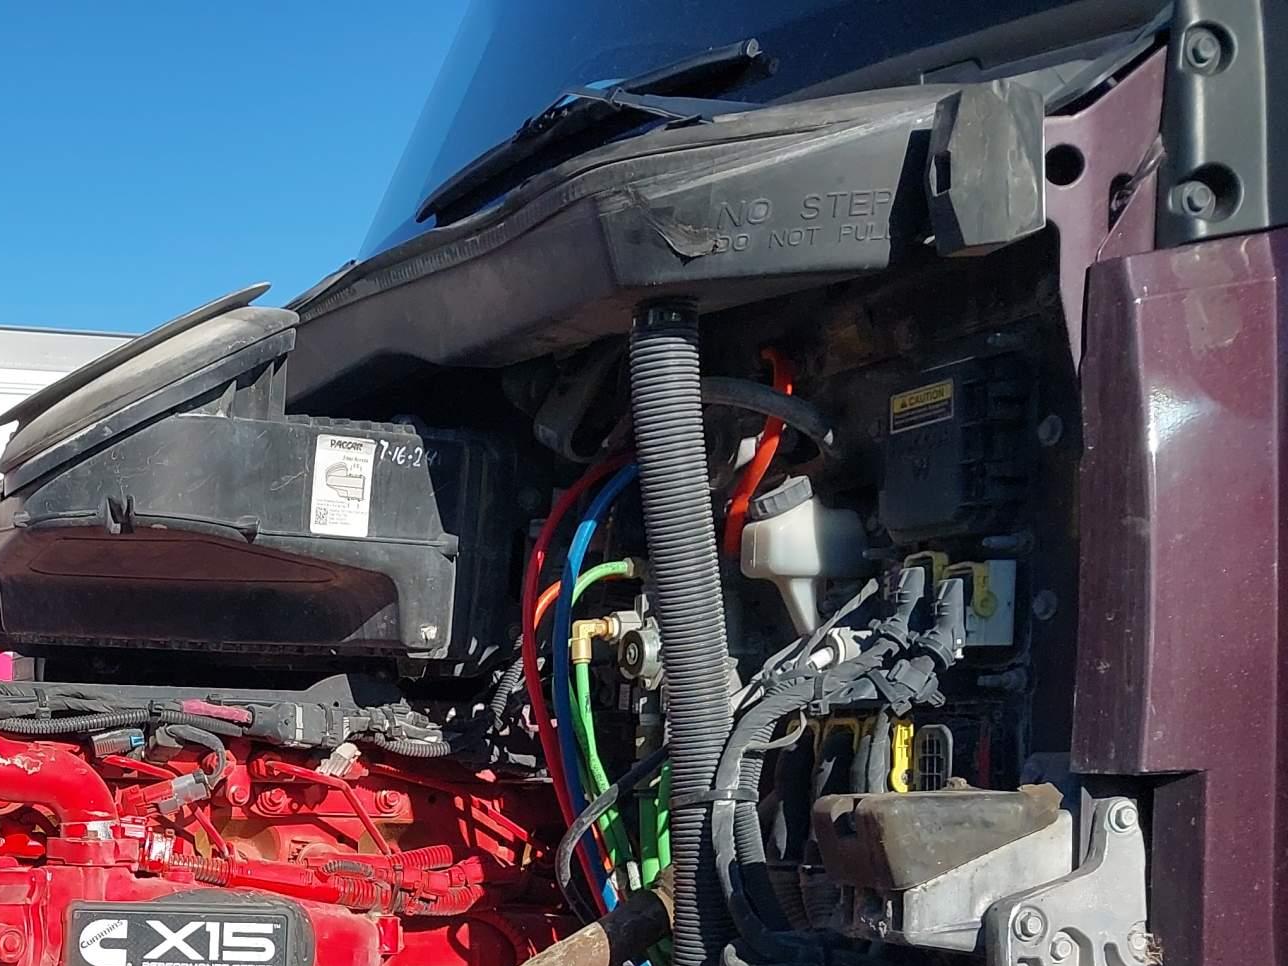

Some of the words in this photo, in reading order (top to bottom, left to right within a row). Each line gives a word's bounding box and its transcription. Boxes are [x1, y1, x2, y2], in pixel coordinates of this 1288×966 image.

[717, 197, 772, 229] NO
[768, 227, 821, 248] NOT
[80, 918, 125, 951] Cummins
